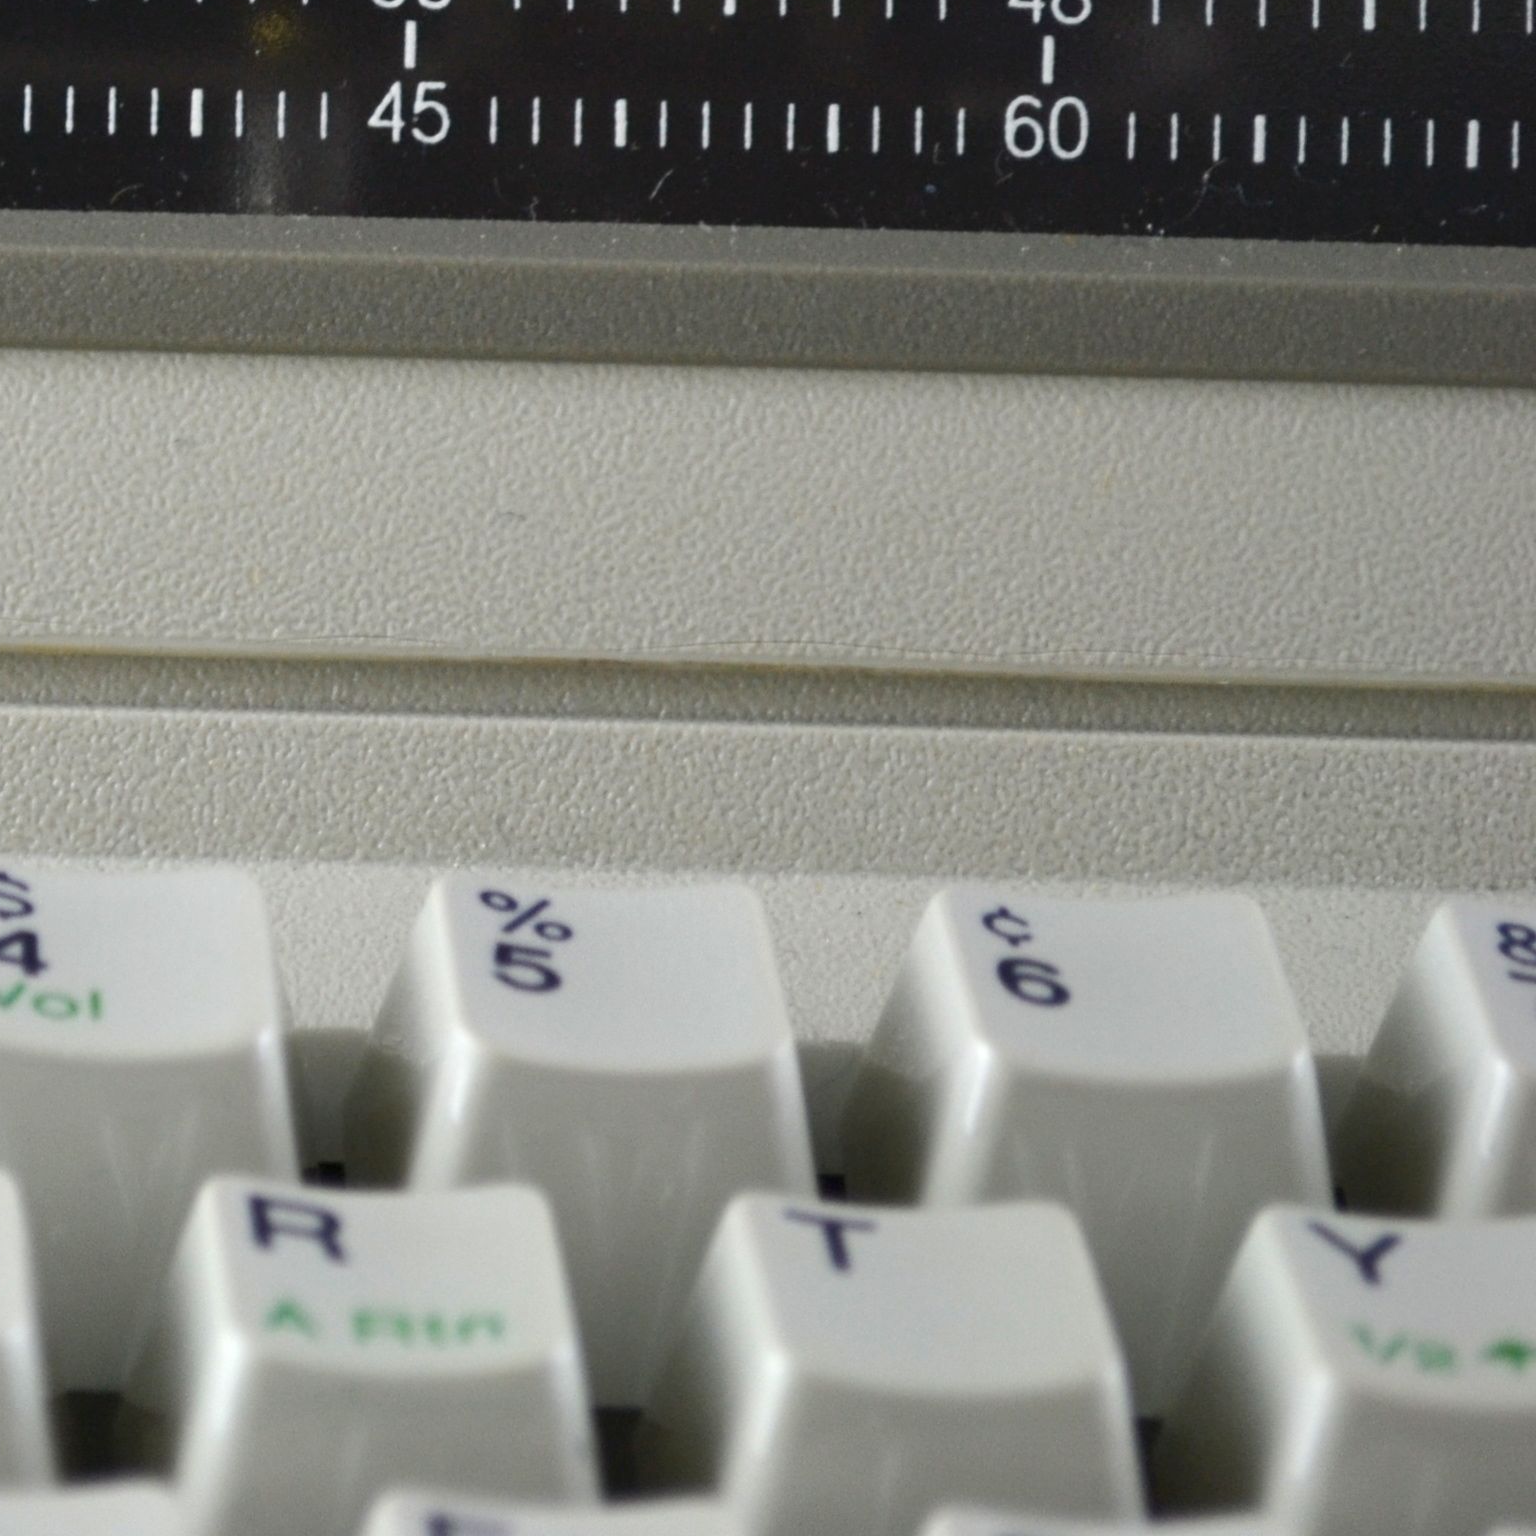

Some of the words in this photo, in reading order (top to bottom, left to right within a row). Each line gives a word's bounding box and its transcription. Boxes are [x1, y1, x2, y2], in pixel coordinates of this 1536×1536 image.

[367, 80, 451, 145] 45
[1004, 94, 1089, 160] 60
[478, 889, 574, 943] %
[492, 942, 563, 995] 5
[995, 956, 1071, 1008] 6
[248, 1194, 348, 1264] R
[783, 1208, 877, 1274] T
[1308, 1220, 1401, 1285] Y
